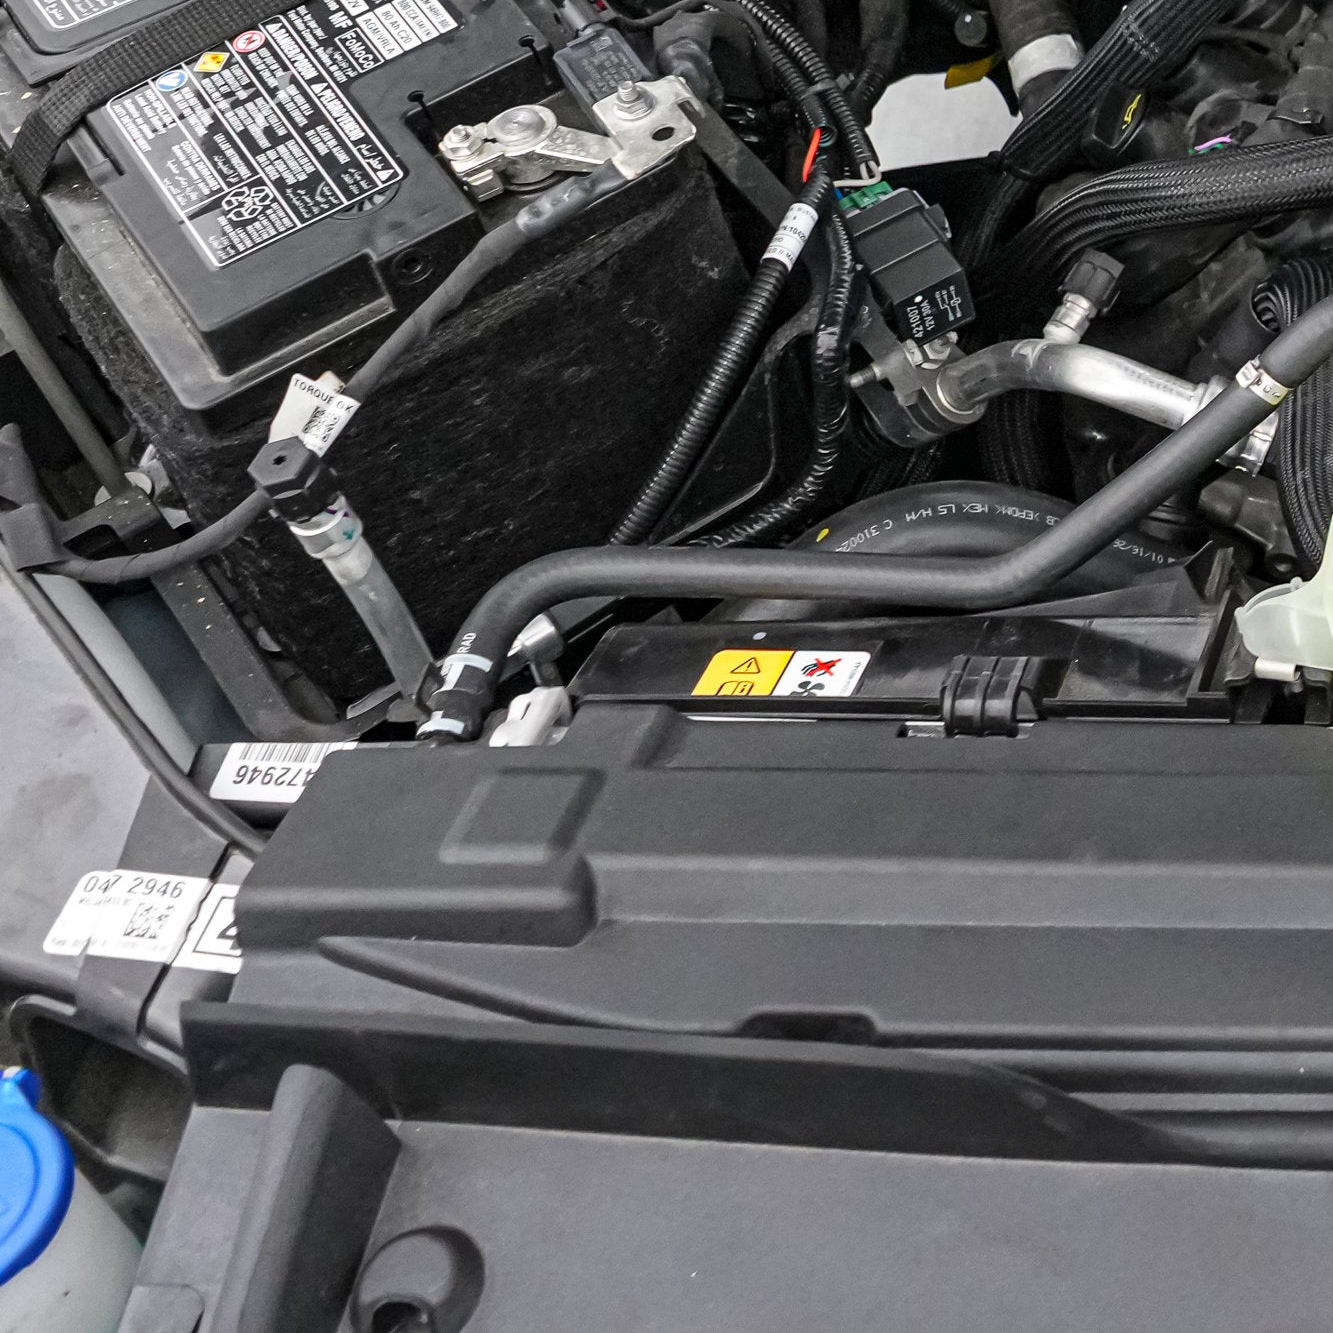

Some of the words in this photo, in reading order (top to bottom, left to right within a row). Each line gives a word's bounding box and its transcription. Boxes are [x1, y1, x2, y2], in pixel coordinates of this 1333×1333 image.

[326, 9, 354, 32] MF
[379, 8, 396, 22] 80
[387, 18, 403, 31] Ah
[360, 16, 397, 55] AGM/VRLA
[395, 27, 414, 44] C20
[339, 30, 379, 70] FoMoCo
[268, 27, 321, 81] DANGER/POISON
[313, 87, 367, 142] PELIGRO/VENENO
[906, 306, 923, 339] 421007
[292, 377, 334, 405] TORQUE
[336, 400, 355, 414] OK
[962, 503, 989, 514] MEX
[883, 518, 894, 531] C
[456, 631, 477, 654] RAD
[127, 877, 186, 899] 2946
